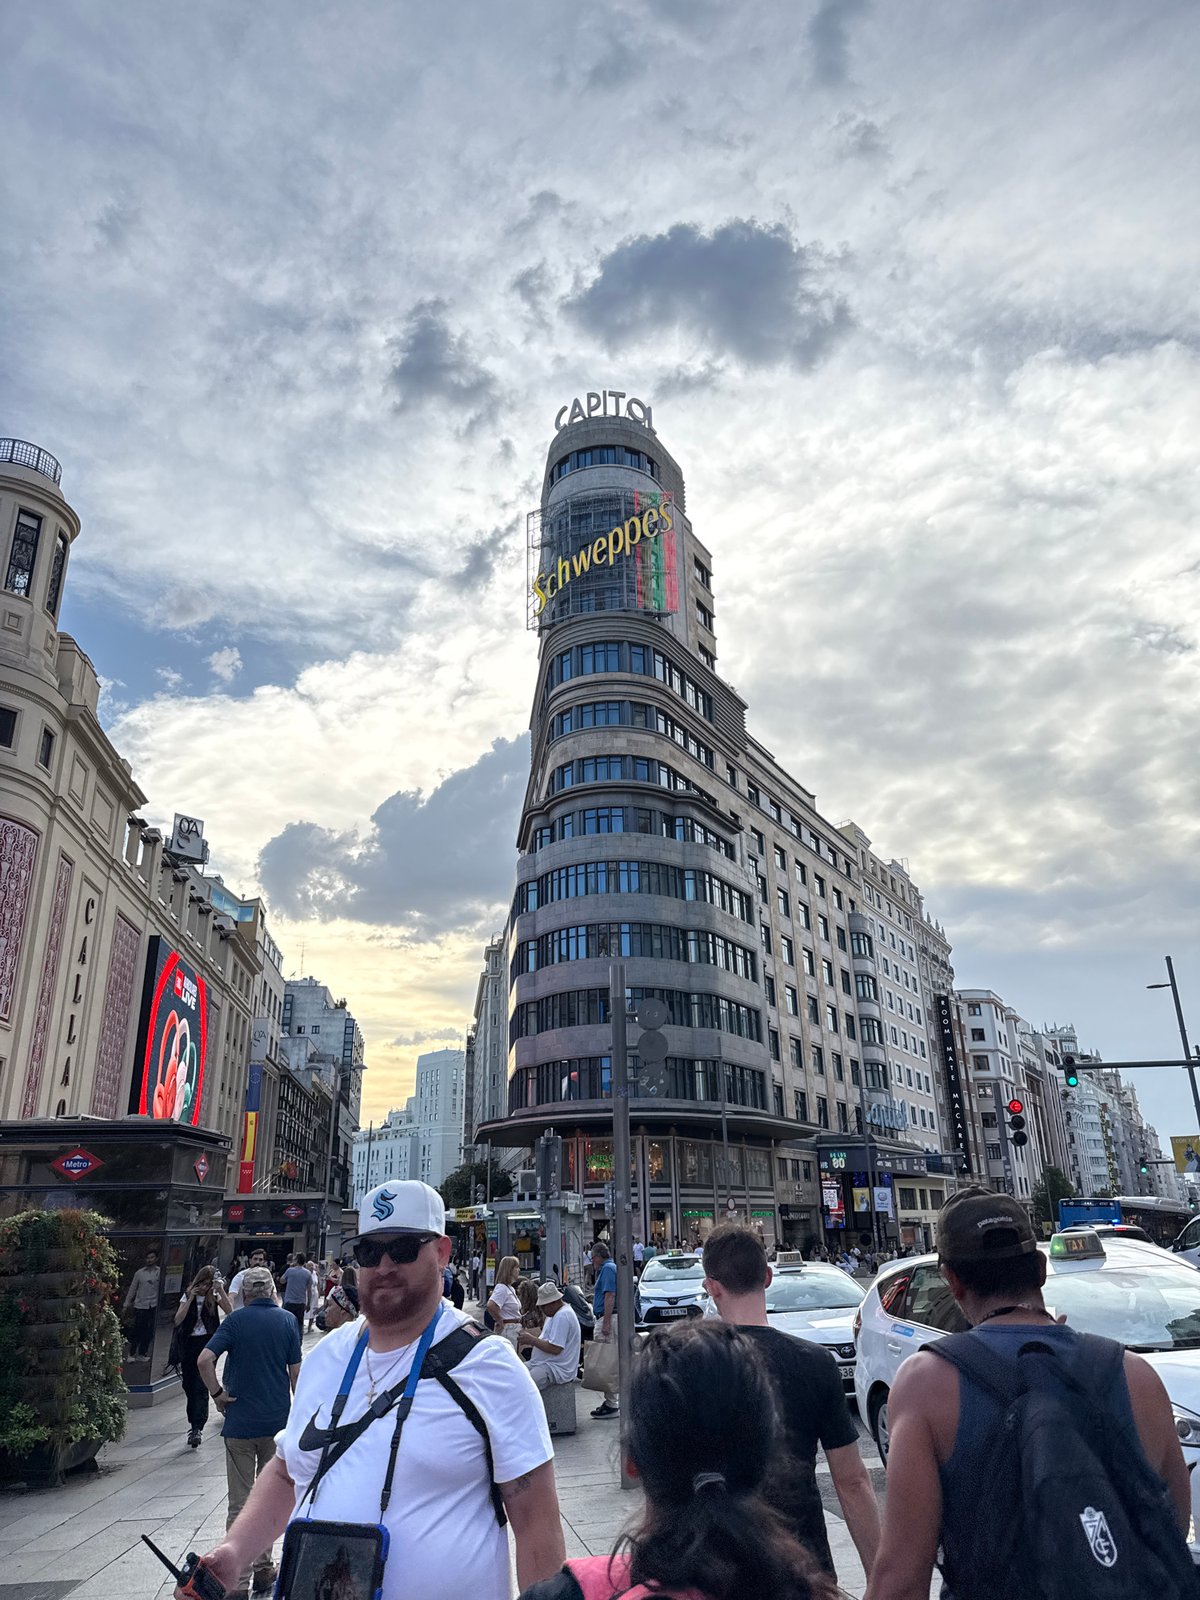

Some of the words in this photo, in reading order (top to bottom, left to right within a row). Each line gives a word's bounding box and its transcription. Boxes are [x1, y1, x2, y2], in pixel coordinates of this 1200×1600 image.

[532, 500, 674, 617] Schweppes
[181, 987, 197, 1011] LIVE
[941, 1000, 951, 1034] ROOM
[946, 1046, 956, 1082] MATE
[65, 1160, 88, 1168] Metro
[976, 1216, 1013, 1229] patagonia
[1065, 1238, 1086, 1252] TAX
